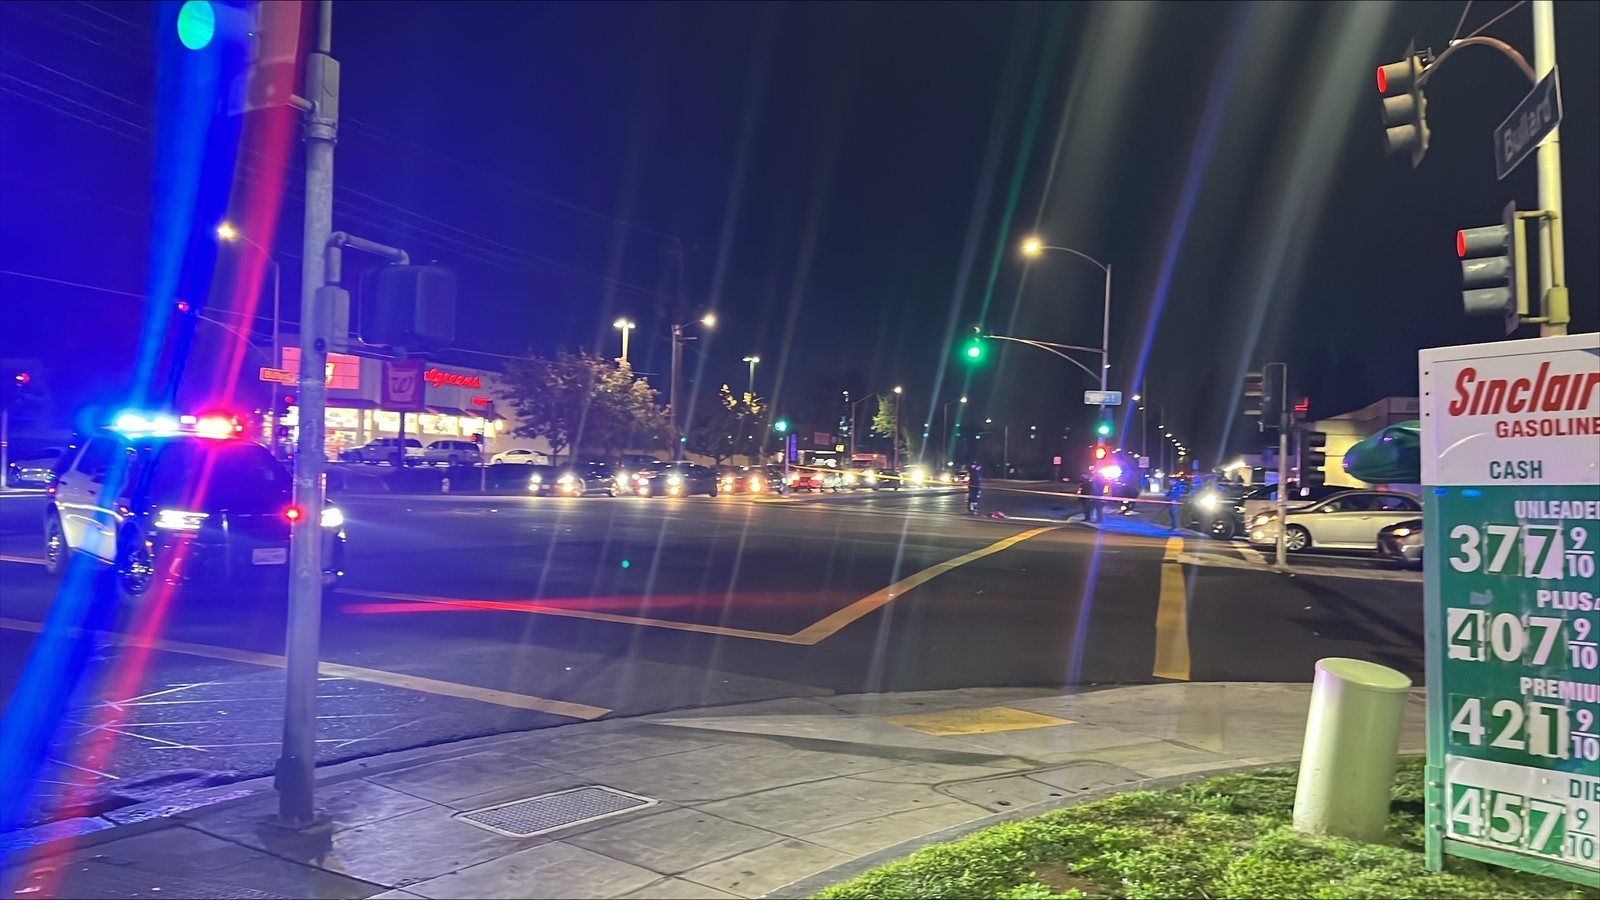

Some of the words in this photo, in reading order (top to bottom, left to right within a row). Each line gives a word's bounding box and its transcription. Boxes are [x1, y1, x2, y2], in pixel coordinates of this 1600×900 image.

[1448, 361, 1600, 417] Sinclair
[1496, 416, 1600, 438] GASOLINE
[1489, 460, 1543, 480] CASH
[1449, 525, 1558, 577] 377
[1450, 612, 1563, 666] 407
[1519, 677, 1600, 703] PREMIU
[1450, 698, 1559, 757] 421
[1452, 789, 1563, 851] 457
